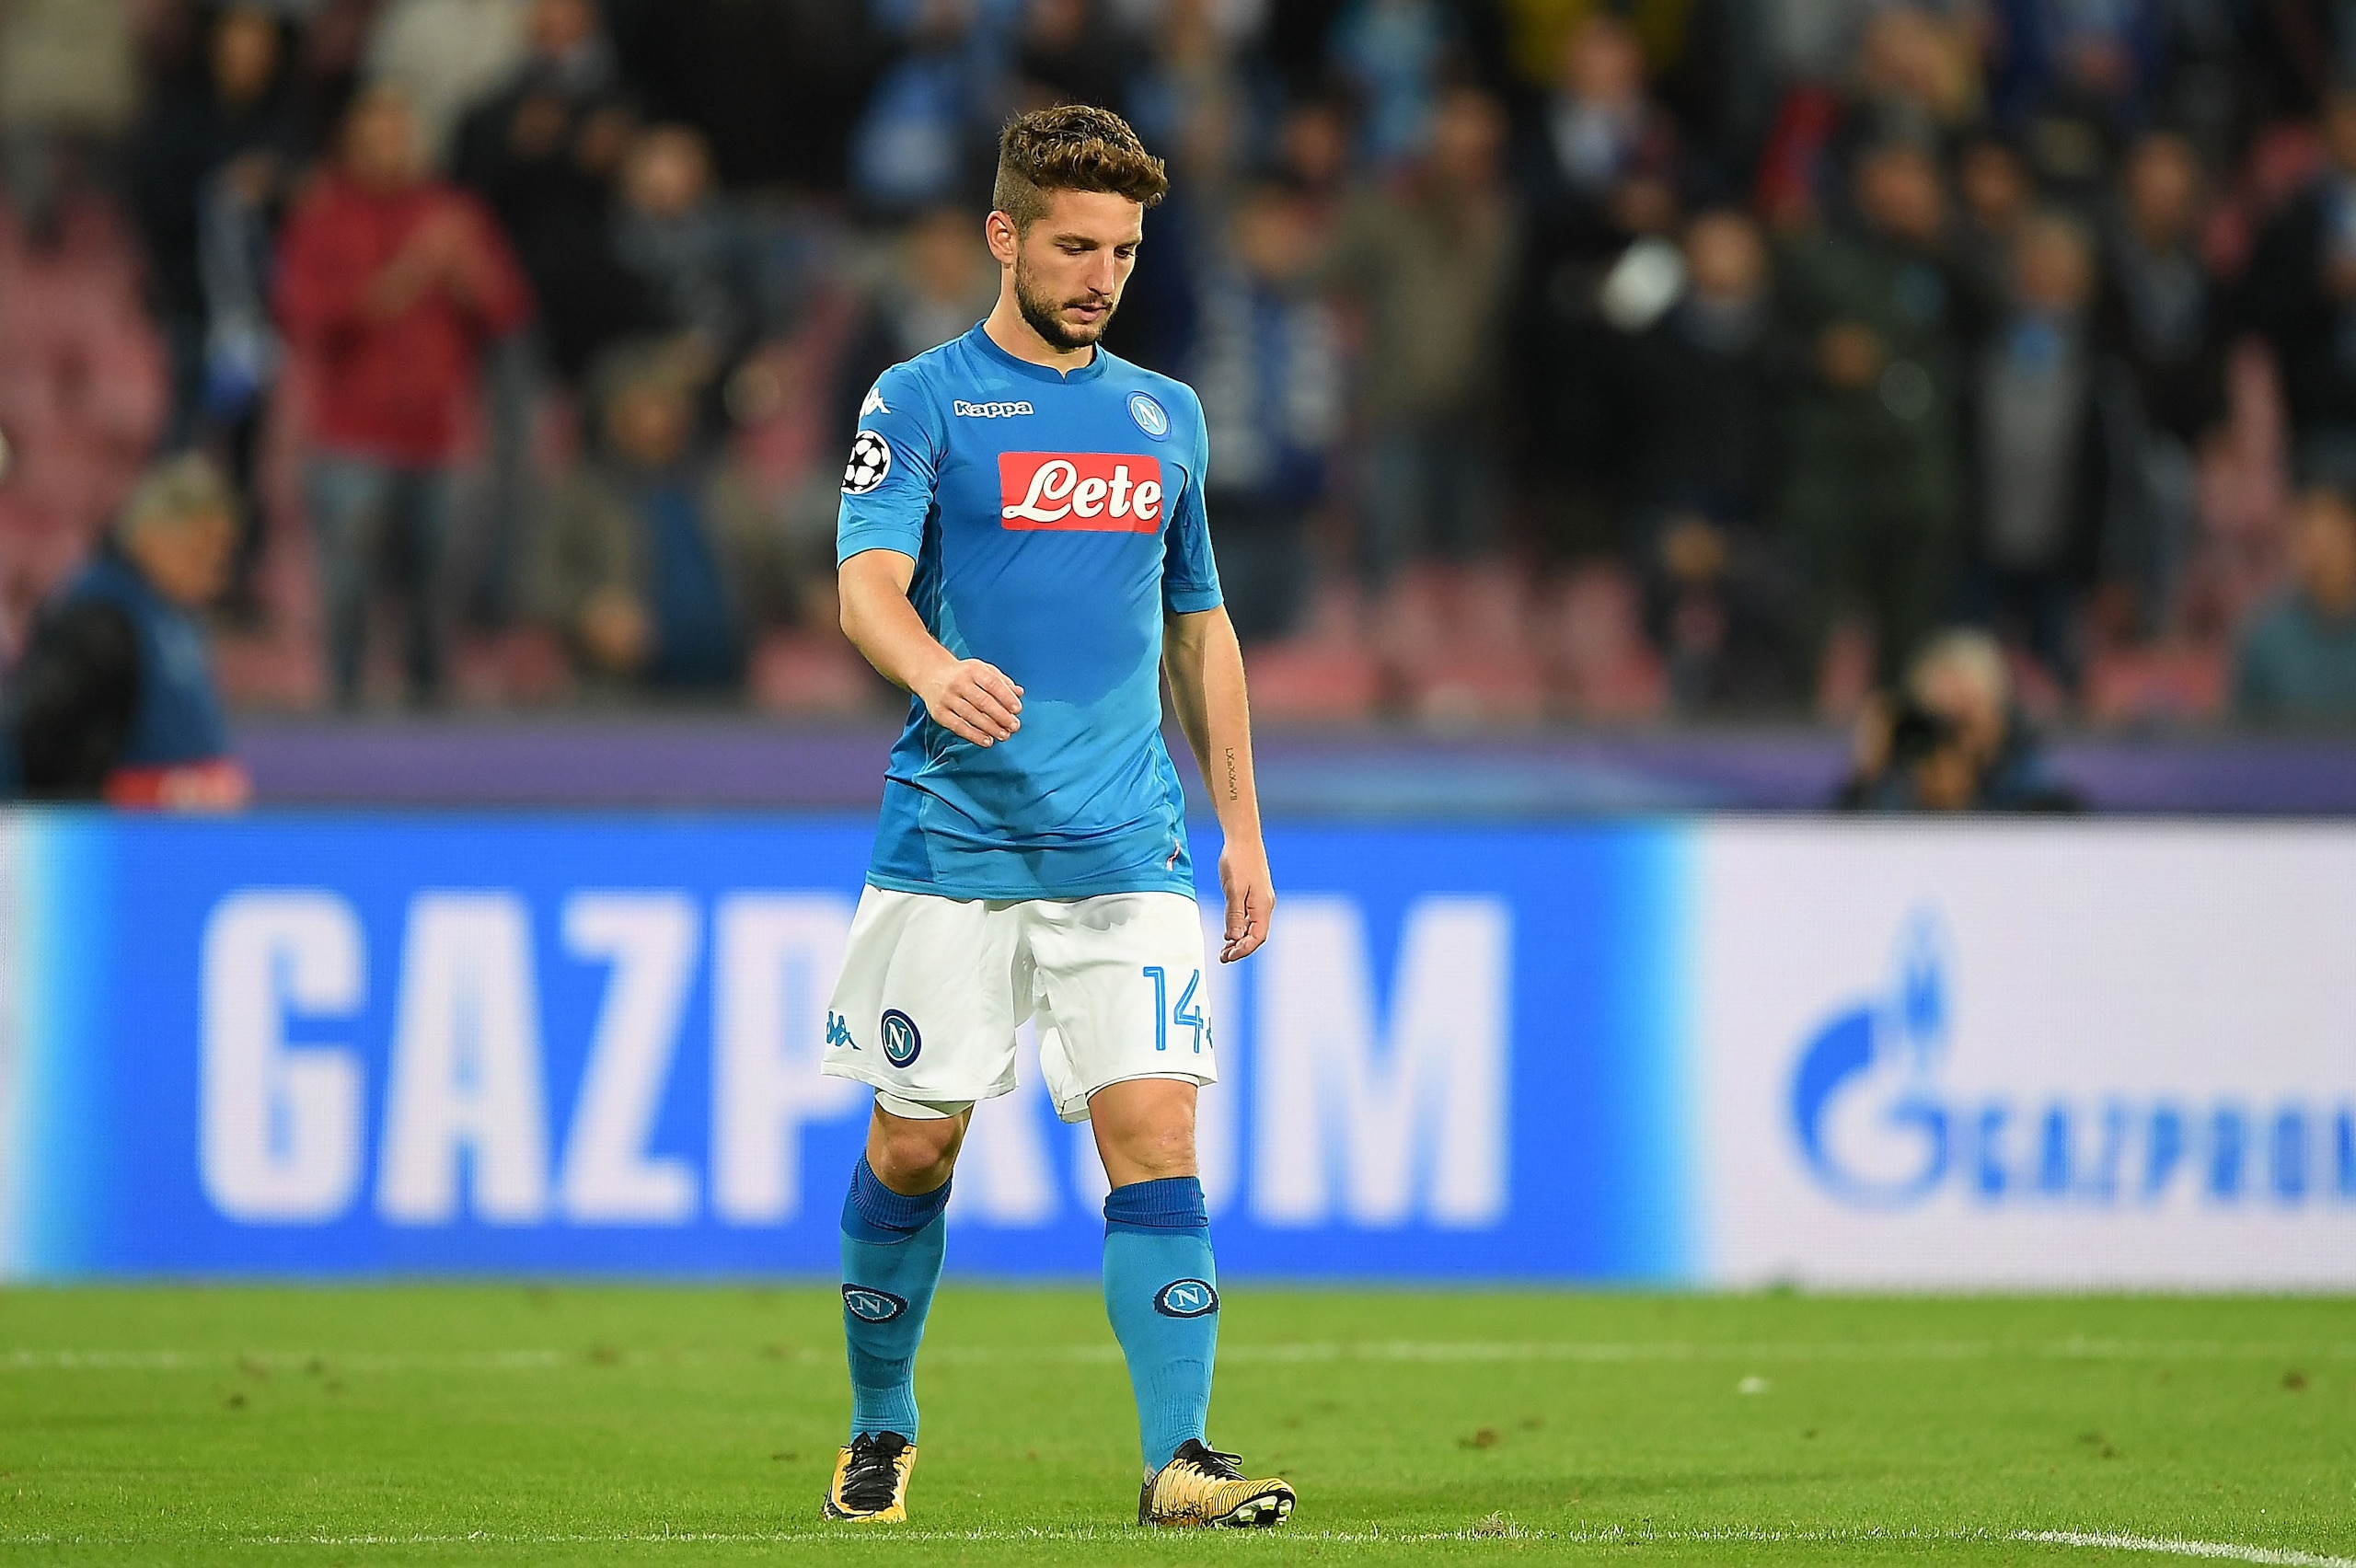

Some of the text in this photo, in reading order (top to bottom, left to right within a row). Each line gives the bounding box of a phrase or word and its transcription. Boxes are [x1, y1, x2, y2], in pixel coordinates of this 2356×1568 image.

[953, 399, 1034, 420] Kappa
[1138, 401, 1161, 428] N
[1002, 459, 1163, 522] Lete
[1142, 966, 1204, 1055] 14
[887, 1022, 907, 1054] N
